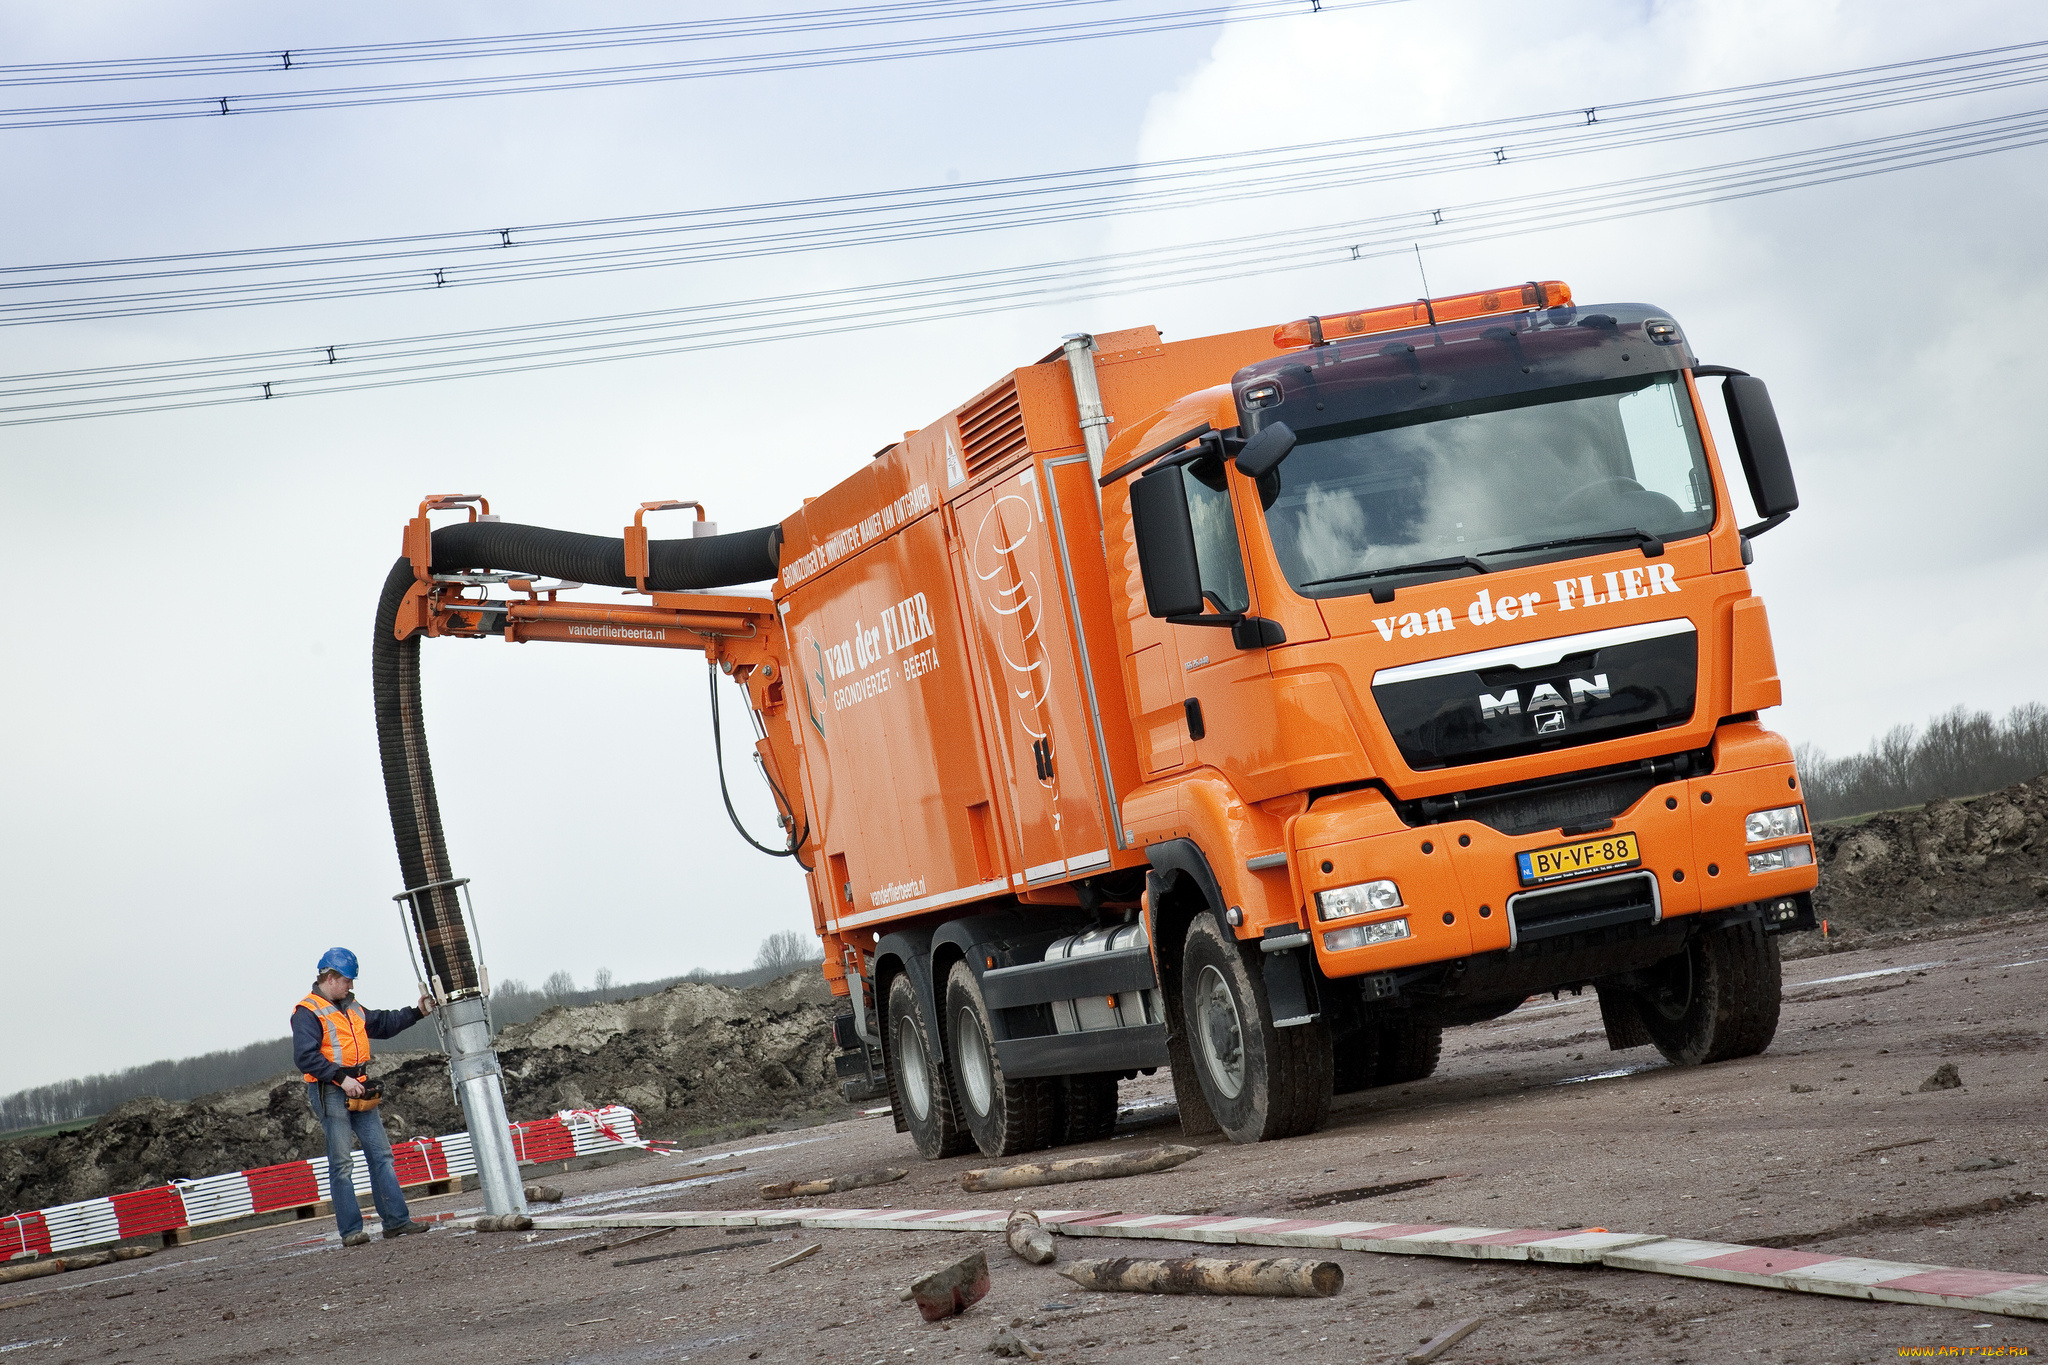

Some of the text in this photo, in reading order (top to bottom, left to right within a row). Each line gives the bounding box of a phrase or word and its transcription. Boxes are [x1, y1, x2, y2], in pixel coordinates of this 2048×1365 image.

[816, 545, 828, 569] DE
[858, 511, 884, 545] MANIER
[880, 504, 896, 531] VAN
[893, 482, 932, 525] ONTGRAVEN
[1371, 563, 1682, 642] van der FLIER
[568, 624, 666, 641] vanderflierbeerta.nl
[824, 591, 934, 681] van der FLIER
[833, 647, 940, 711] GRONDVERZET BEERTA
[1478, 673, 1612, 719] MAN
[1536, 839, 1629, 874] BV-VF-88
[869, 874, 927, 907] vanderflierbeerta.nl
